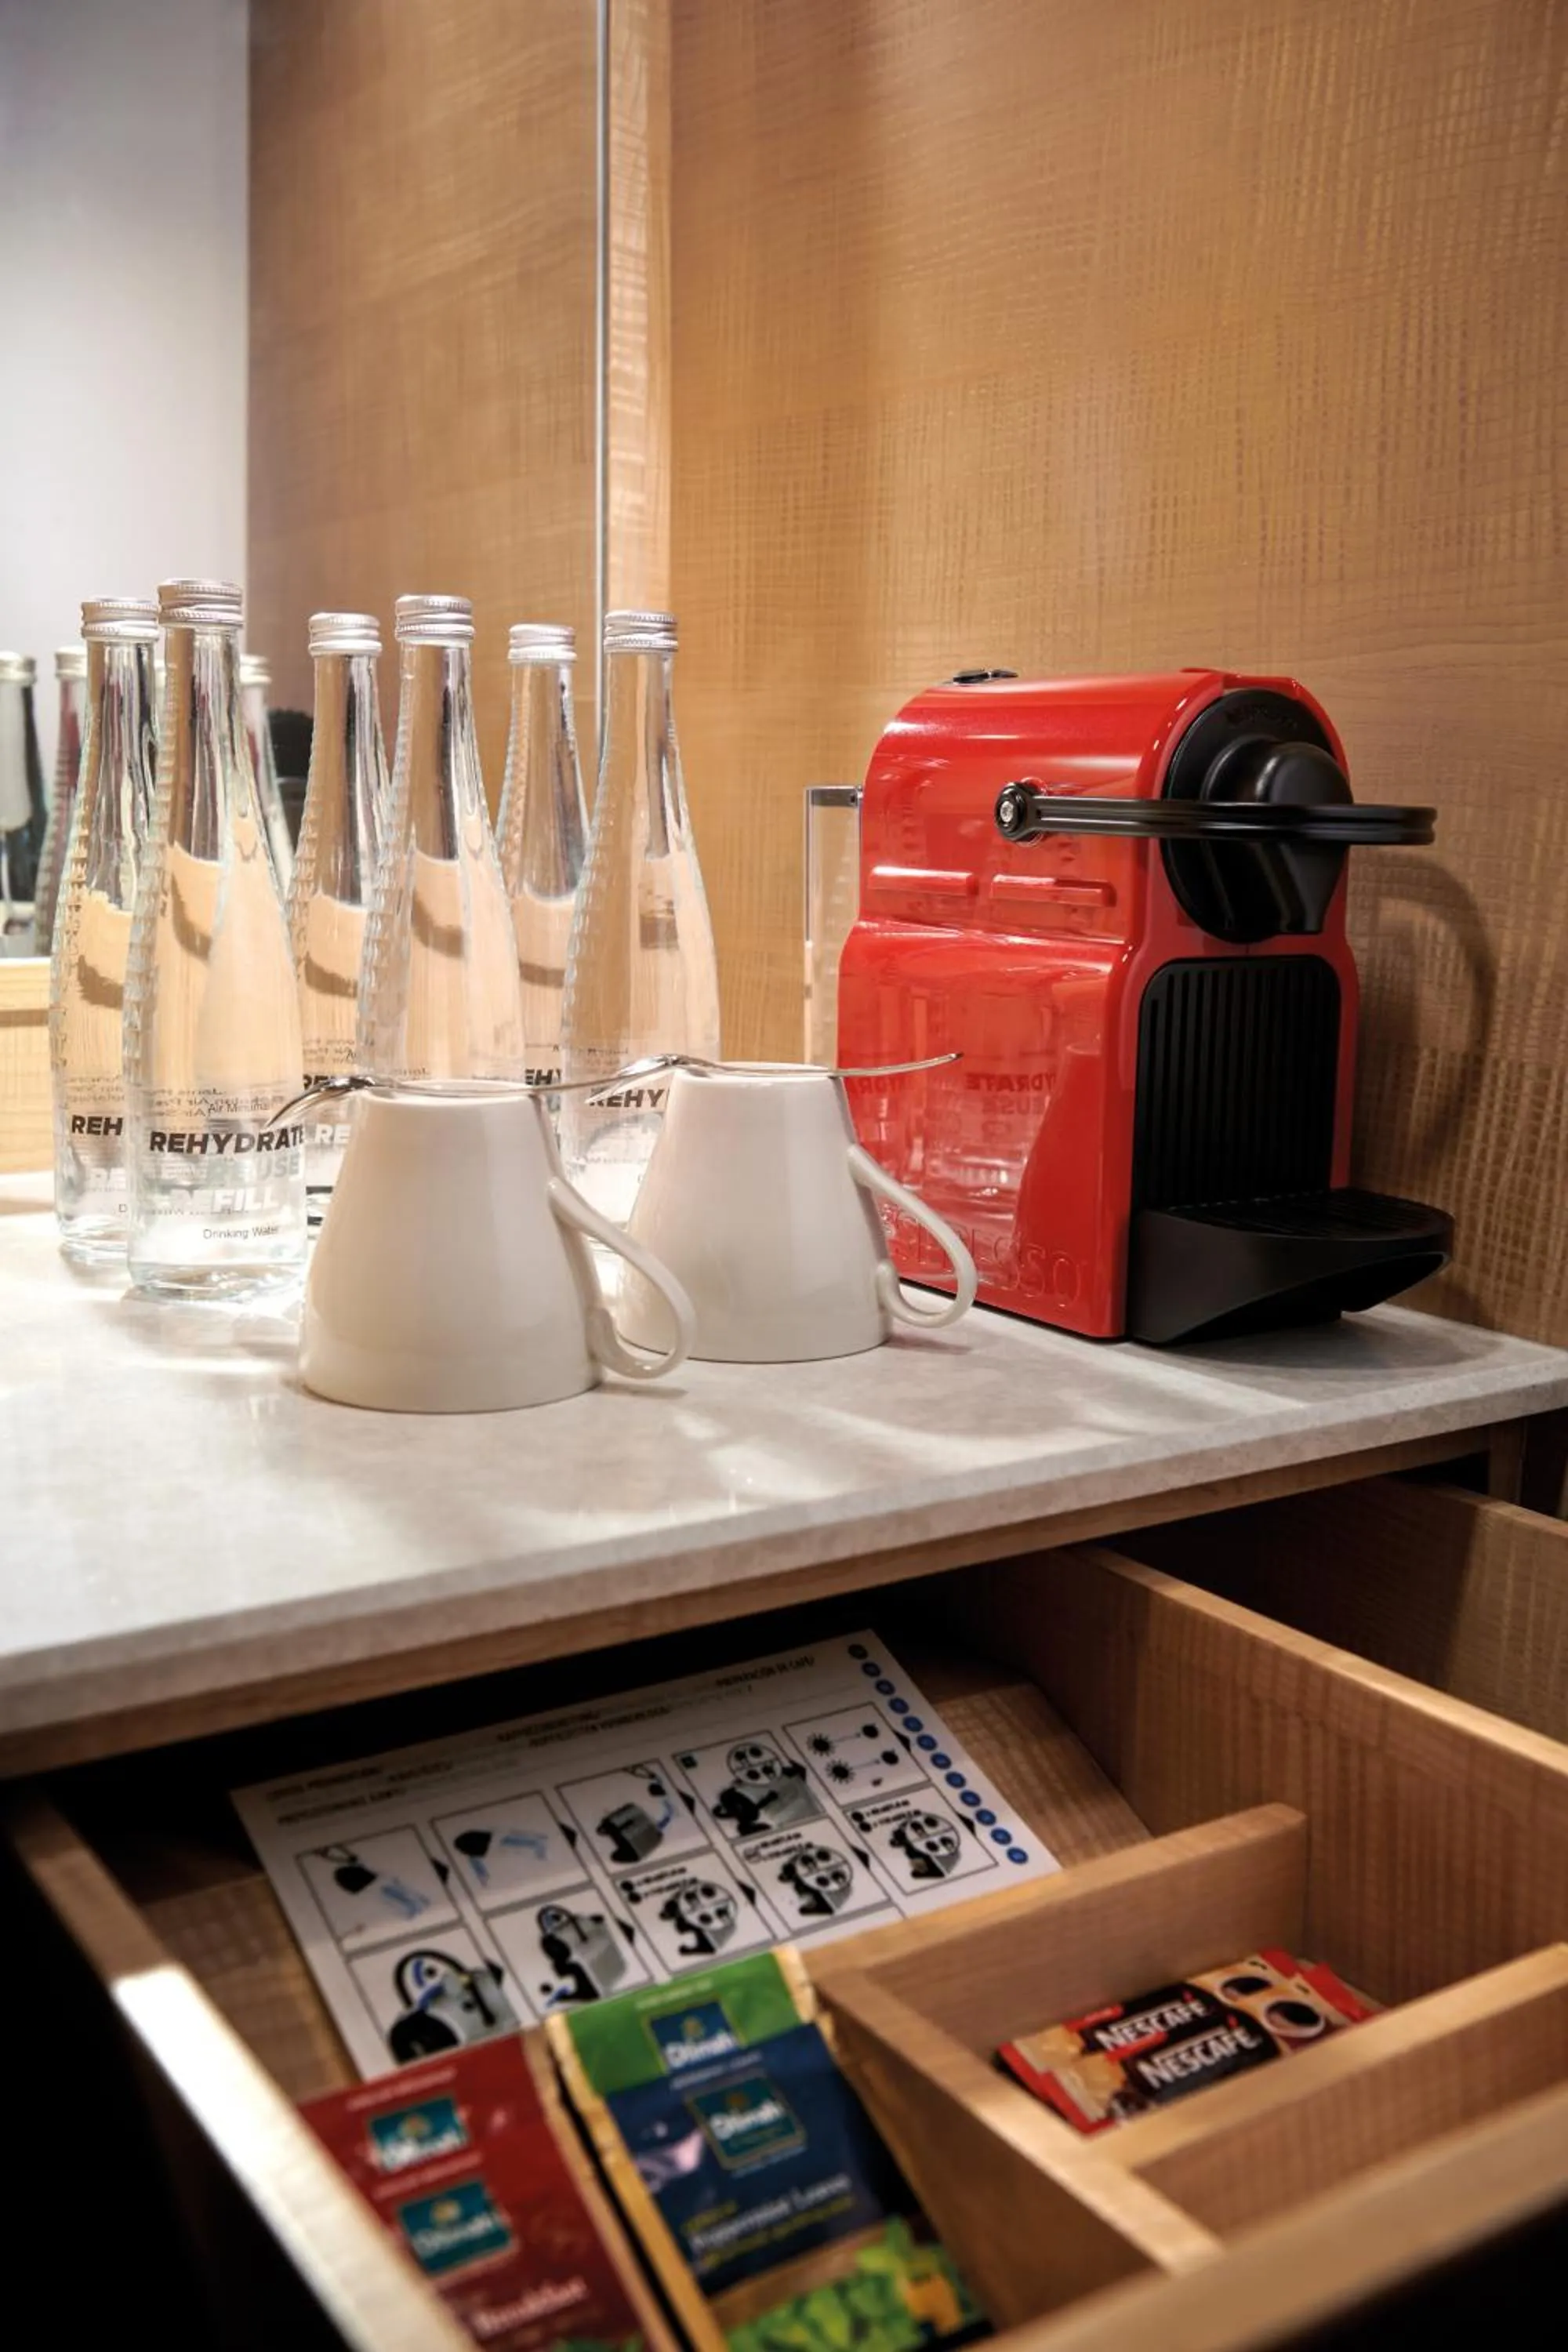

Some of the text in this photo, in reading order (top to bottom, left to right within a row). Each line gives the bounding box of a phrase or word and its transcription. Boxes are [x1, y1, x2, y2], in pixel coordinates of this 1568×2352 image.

[589, 1087, 671, 1108] REHY
[149, 1125, 303, 1155] REHYDRATE
[202, 1225, 278, 1240] Drinking Water
